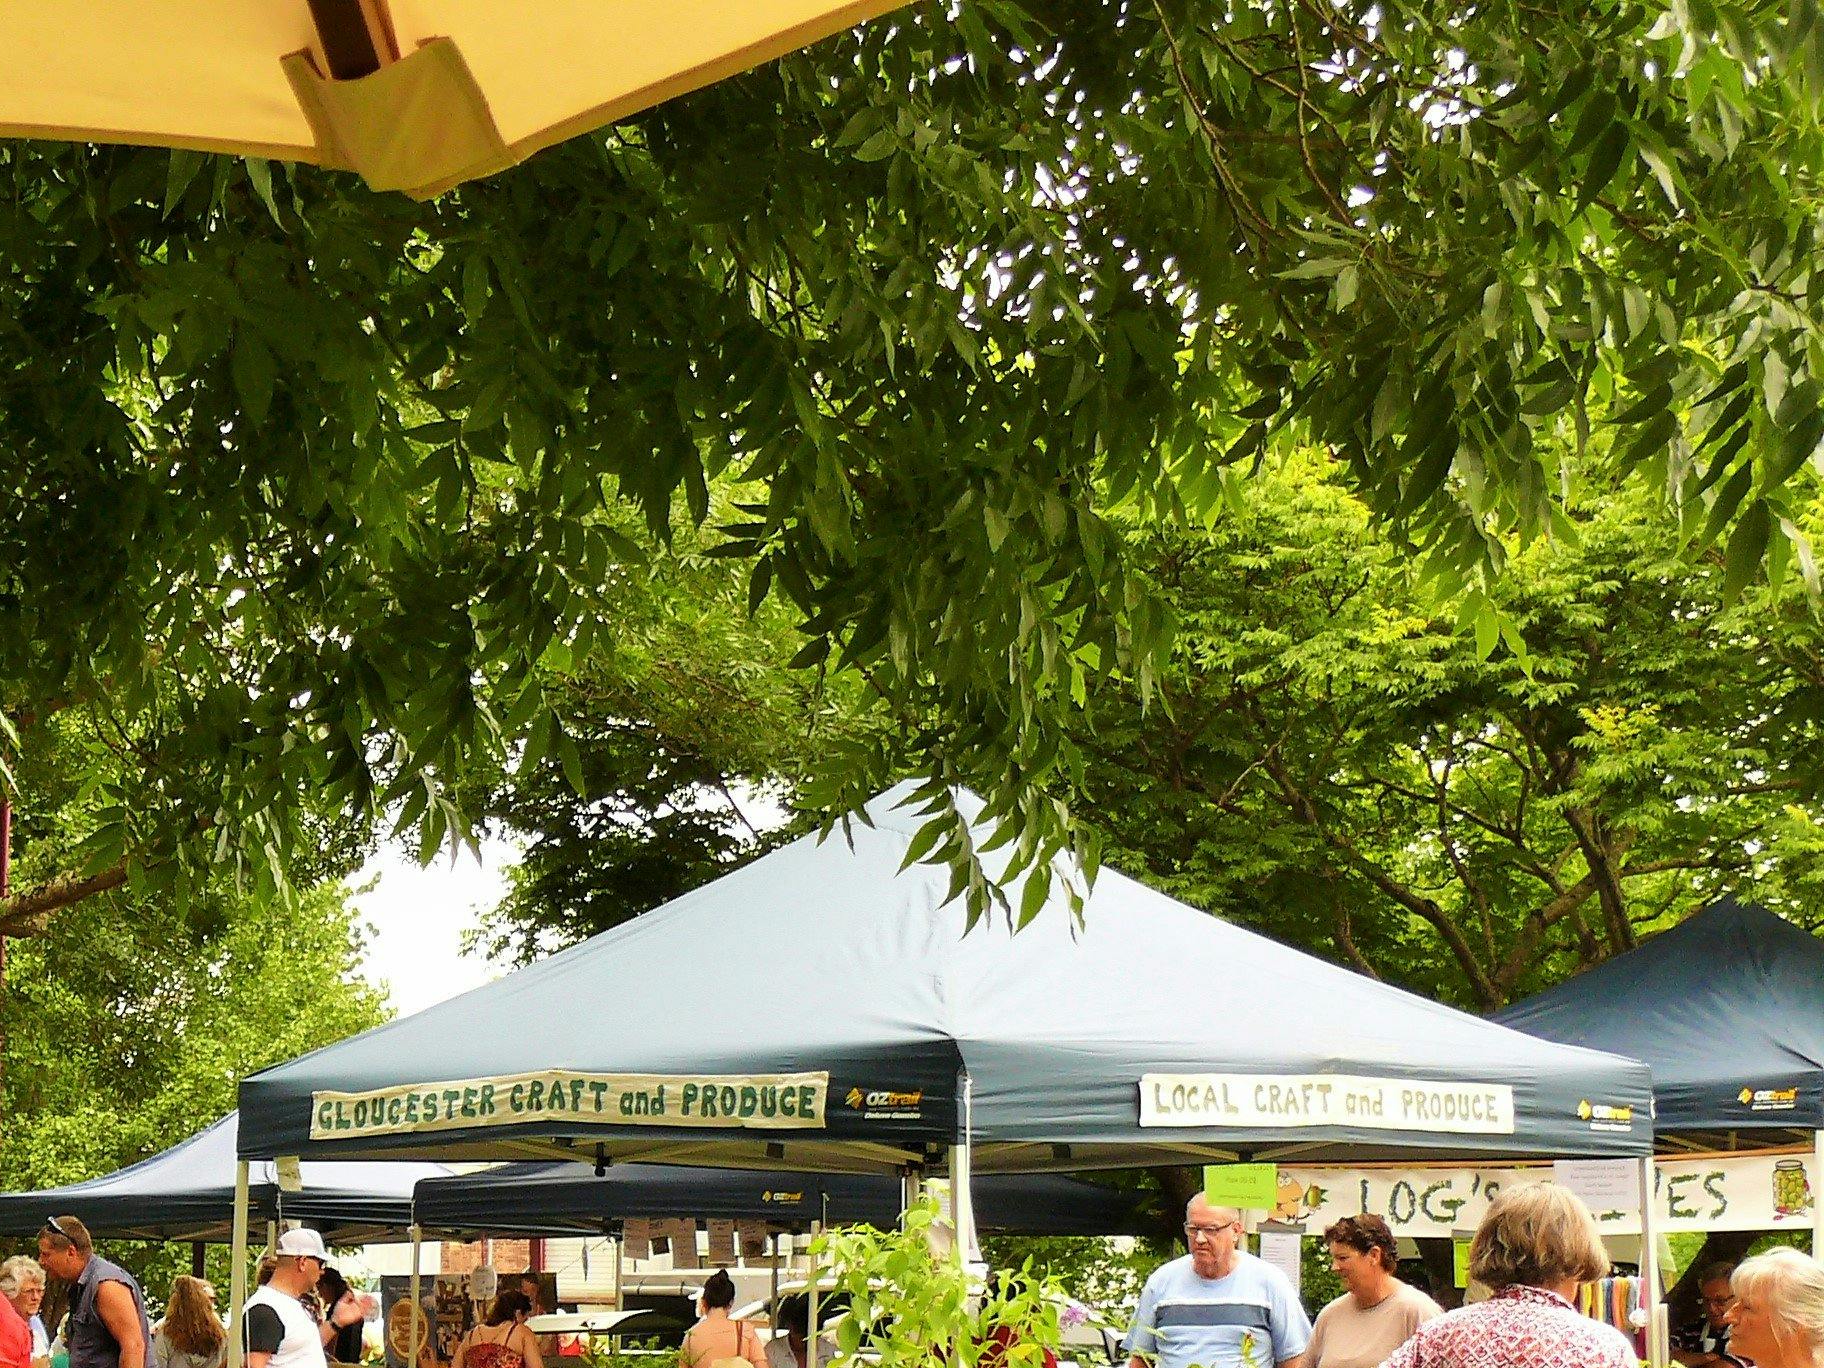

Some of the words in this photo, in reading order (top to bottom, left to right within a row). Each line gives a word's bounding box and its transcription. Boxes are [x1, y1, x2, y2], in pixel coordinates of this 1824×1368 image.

[317, 1083, 495, 1130] GLOUCESTER
[509, 1078, 608, 1113] CRAFT
[619, 1084, 665, 1116] and
[680, 1082, 817, 1120] PRODUCE
[1153, 1082, 1240, 1114] LOCAL
[1253, 1082, 1333, 1116] CRAFT
[1345, 1088, 1384, 1117] and
[1401, 1088, 1499, 1123] PRODUCE
